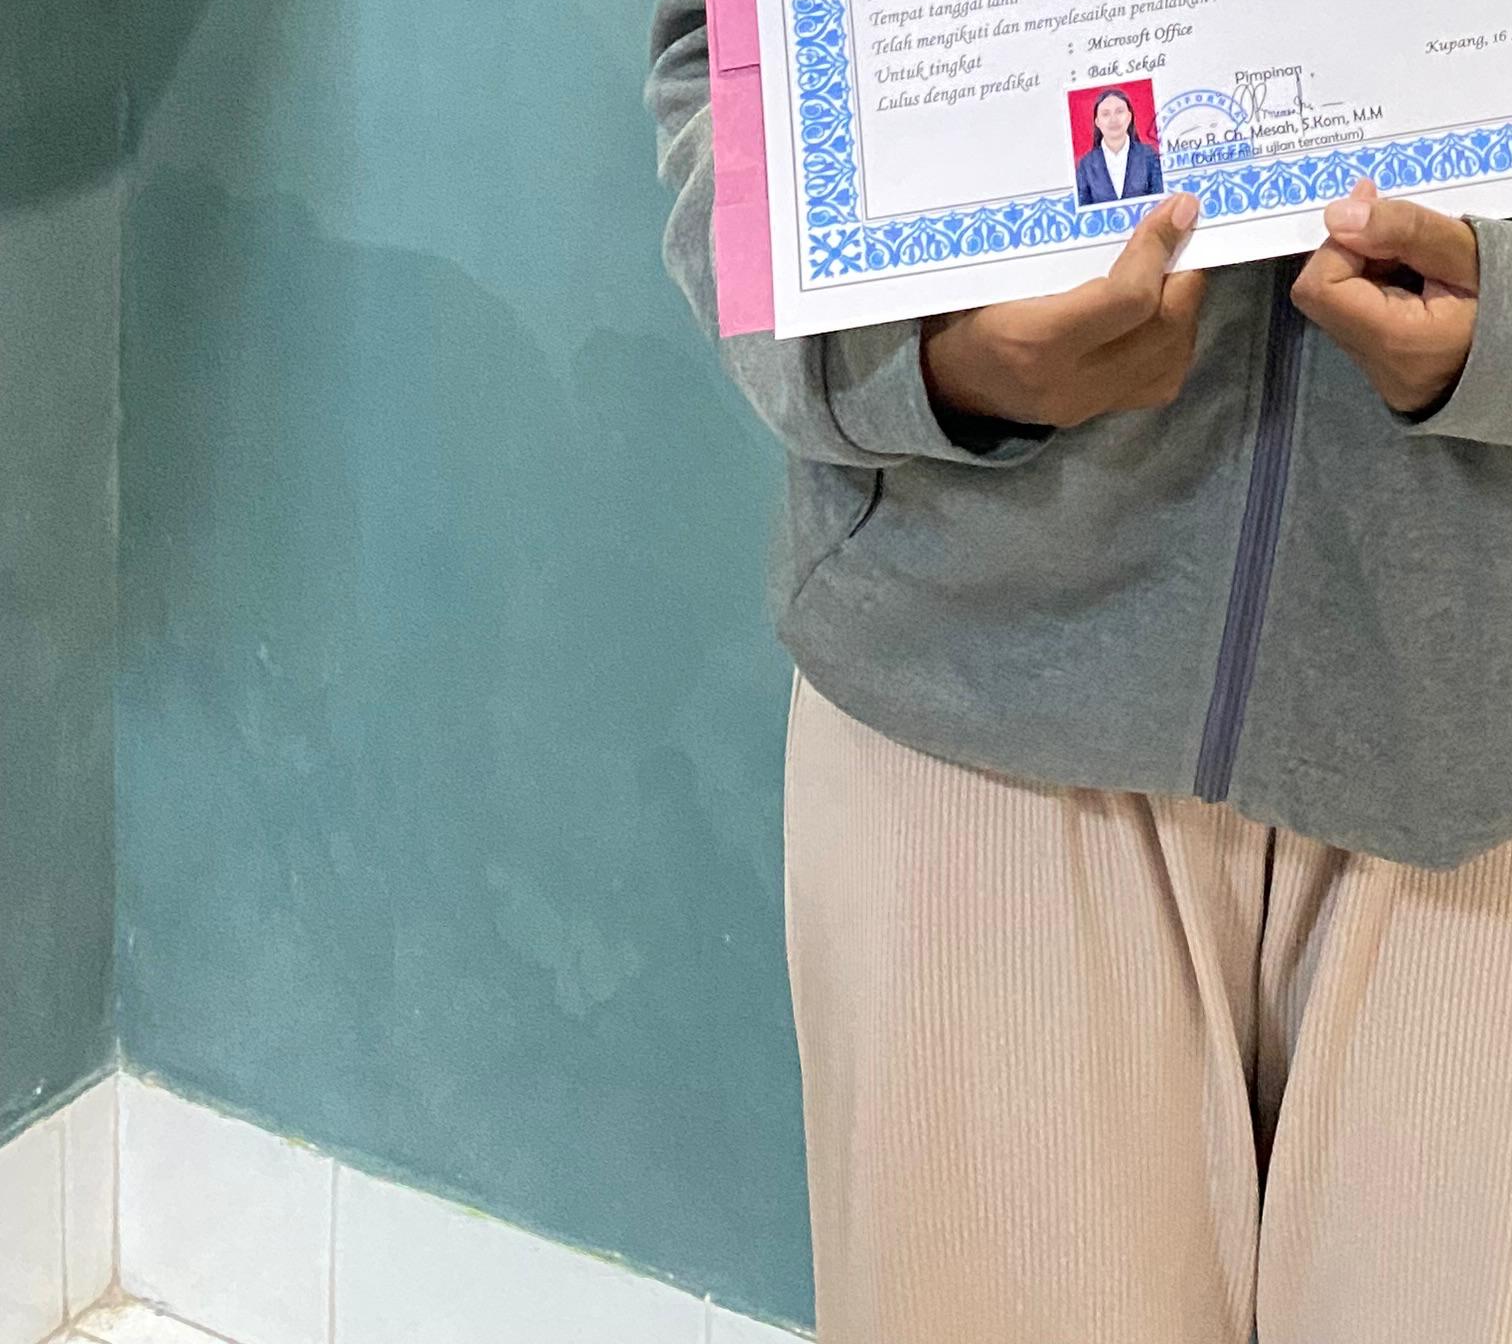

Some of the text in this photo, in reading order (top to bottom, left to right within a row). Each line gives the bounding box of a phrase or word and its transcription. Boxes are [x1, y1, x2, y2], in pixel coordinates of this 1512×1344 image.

[869, 7, 924, 29] Tempat
[871, 33, 912, 57] Telah
[915, 20, 990, 50] mengikuti
[992, 18, 1020, 38] dan
[1023, 2, 1127, 33] menyelesaikan
[874, 22, 1194, 84] Untuk tingkat Microsoft Office
[1425, 33, 1488, 55] Kupang,
[1493, 30, 1507, 44] 16
[875, 52, 1167, 113] Lulus dengan predikat Baik Sekali
[1234, 64, 1303, 85] Pimpinan
[1167, 135, 1202, 154] Mery
[1353, 104, 1384, 122] M.M
[1265, 140, 1297, 156] ujian
[1298, 127, 1365, 149] tercantum)
